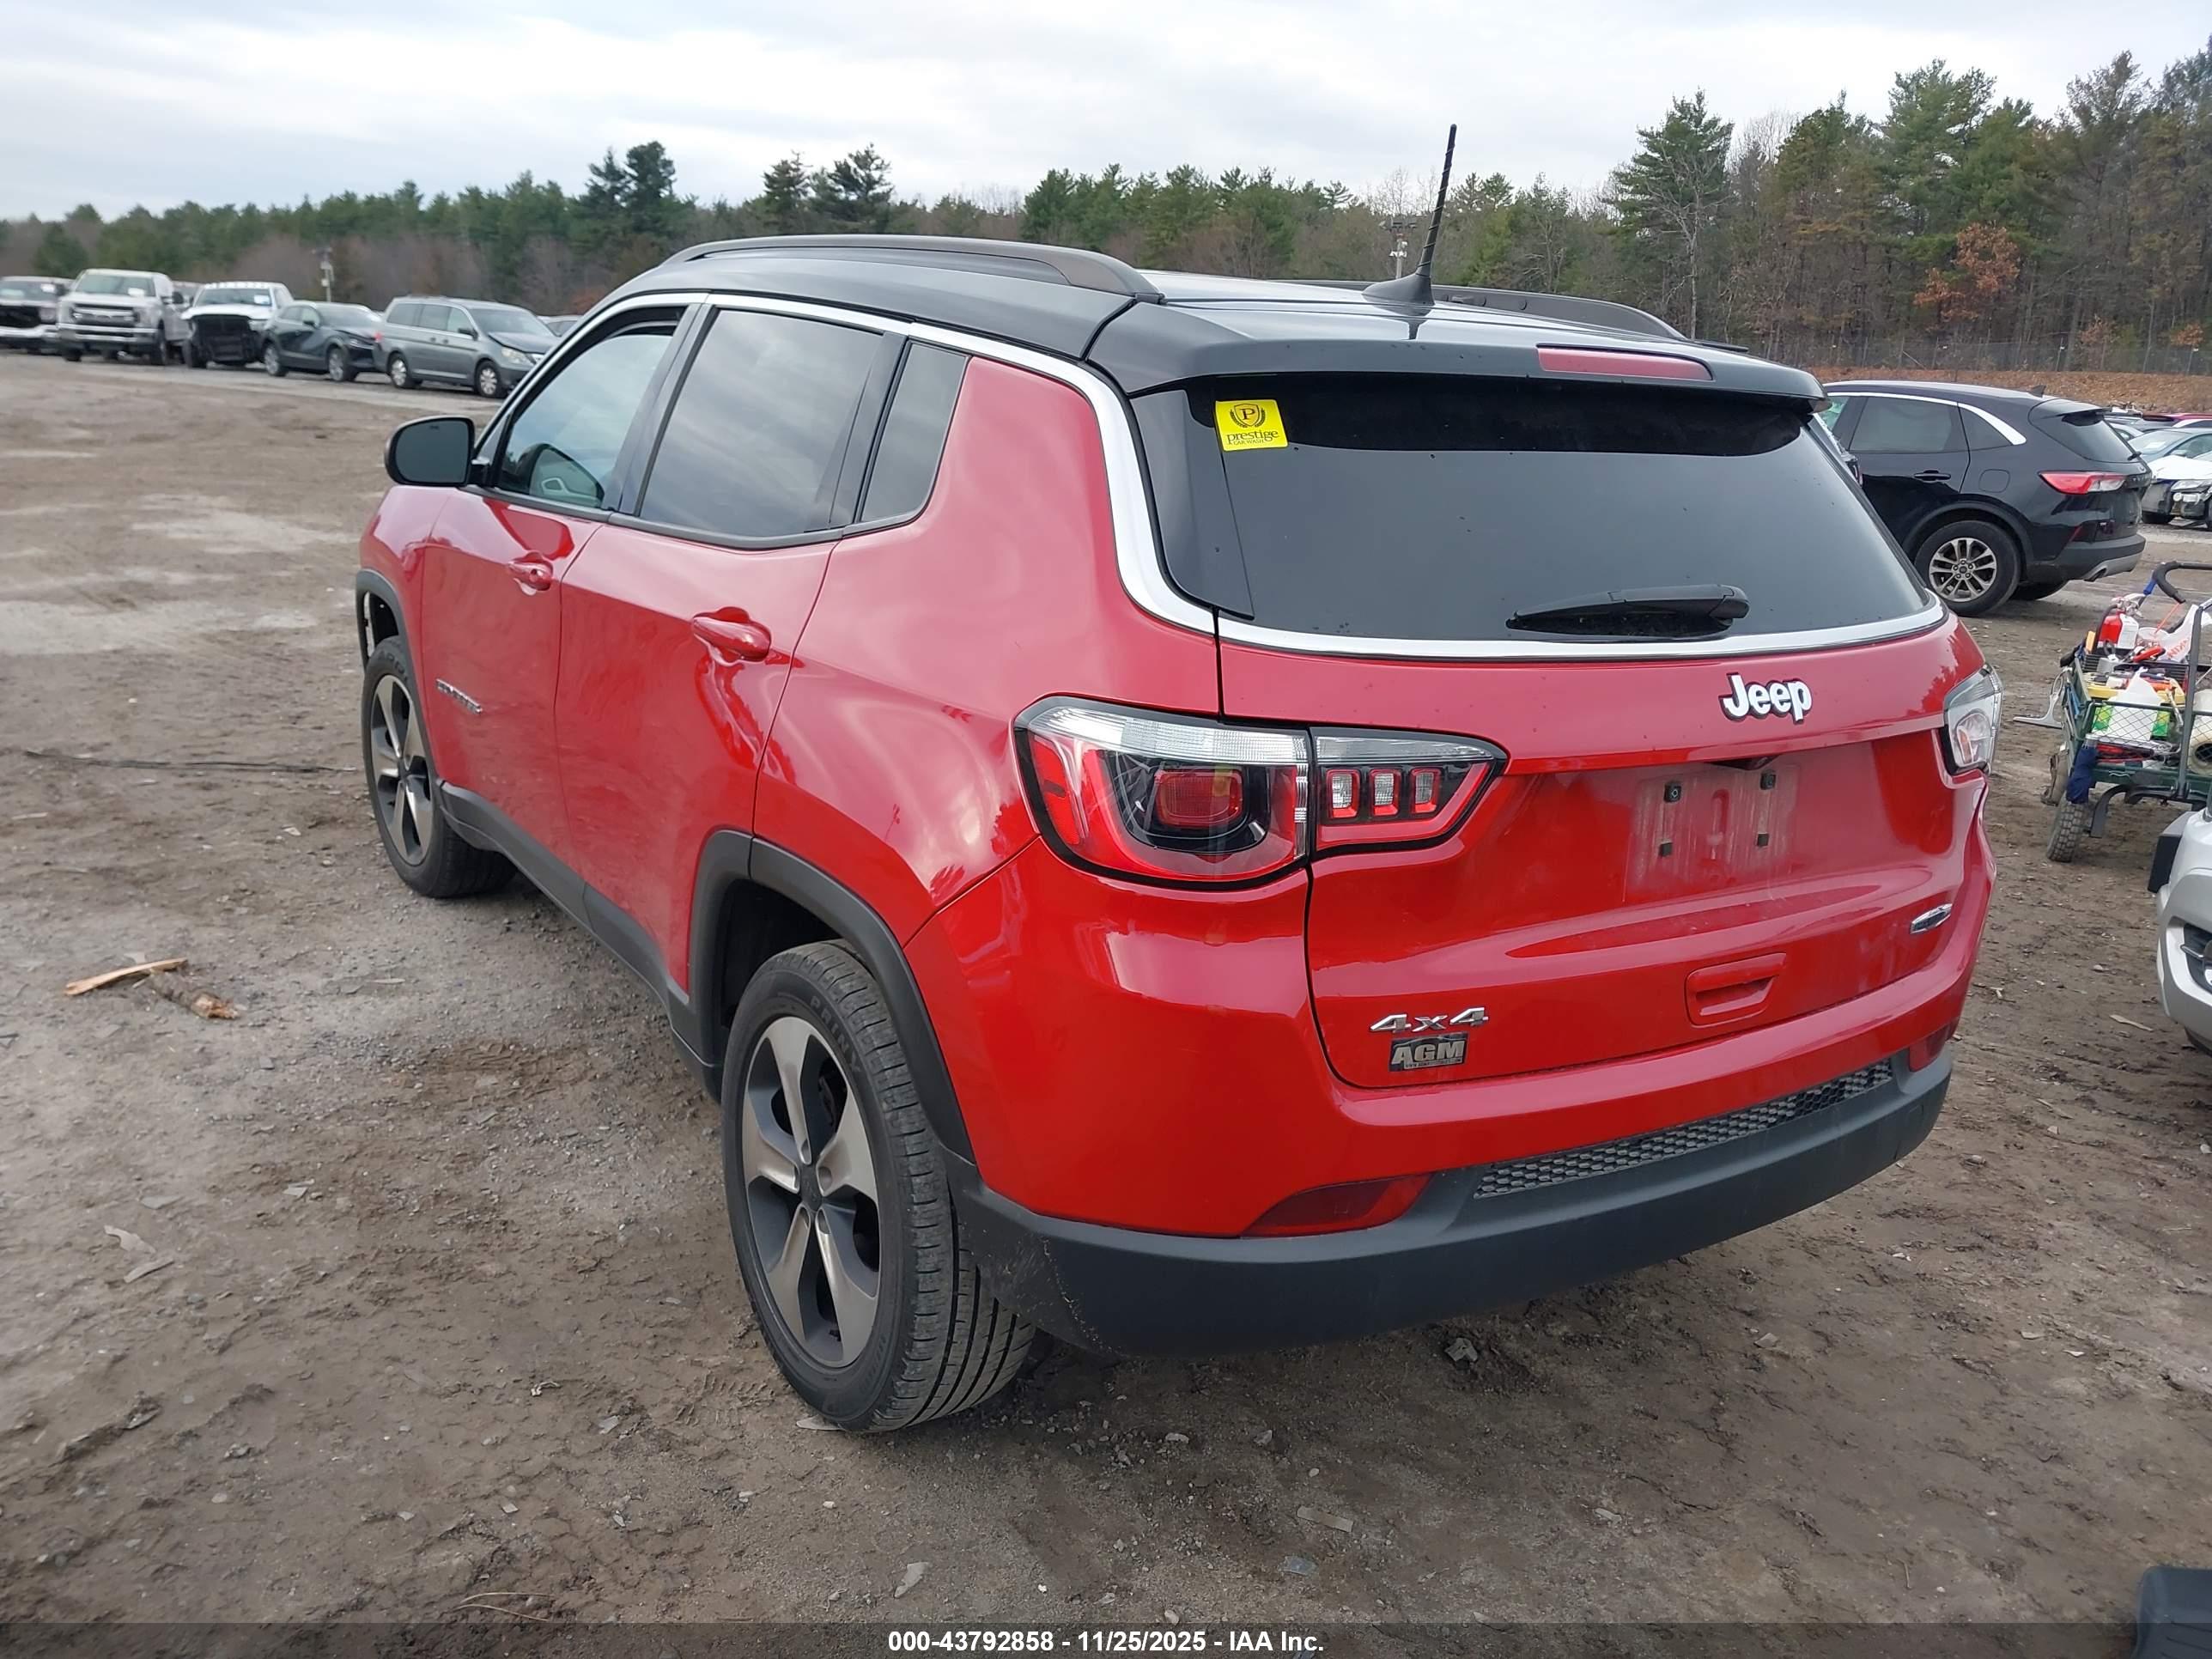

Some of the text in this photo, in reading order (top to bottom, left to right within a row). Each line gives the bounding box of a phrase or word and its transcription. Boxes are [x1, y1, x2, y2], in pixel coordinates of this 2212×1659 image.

[1239, 408, 1255, 421] P
[1226, 429, 1279, 446] prestige
[1718, 672, 1813, 725] Jeep
[1370, 1006, 1489, 1034] 4x4
[1391, 1040, 1466, 1065] AGM
